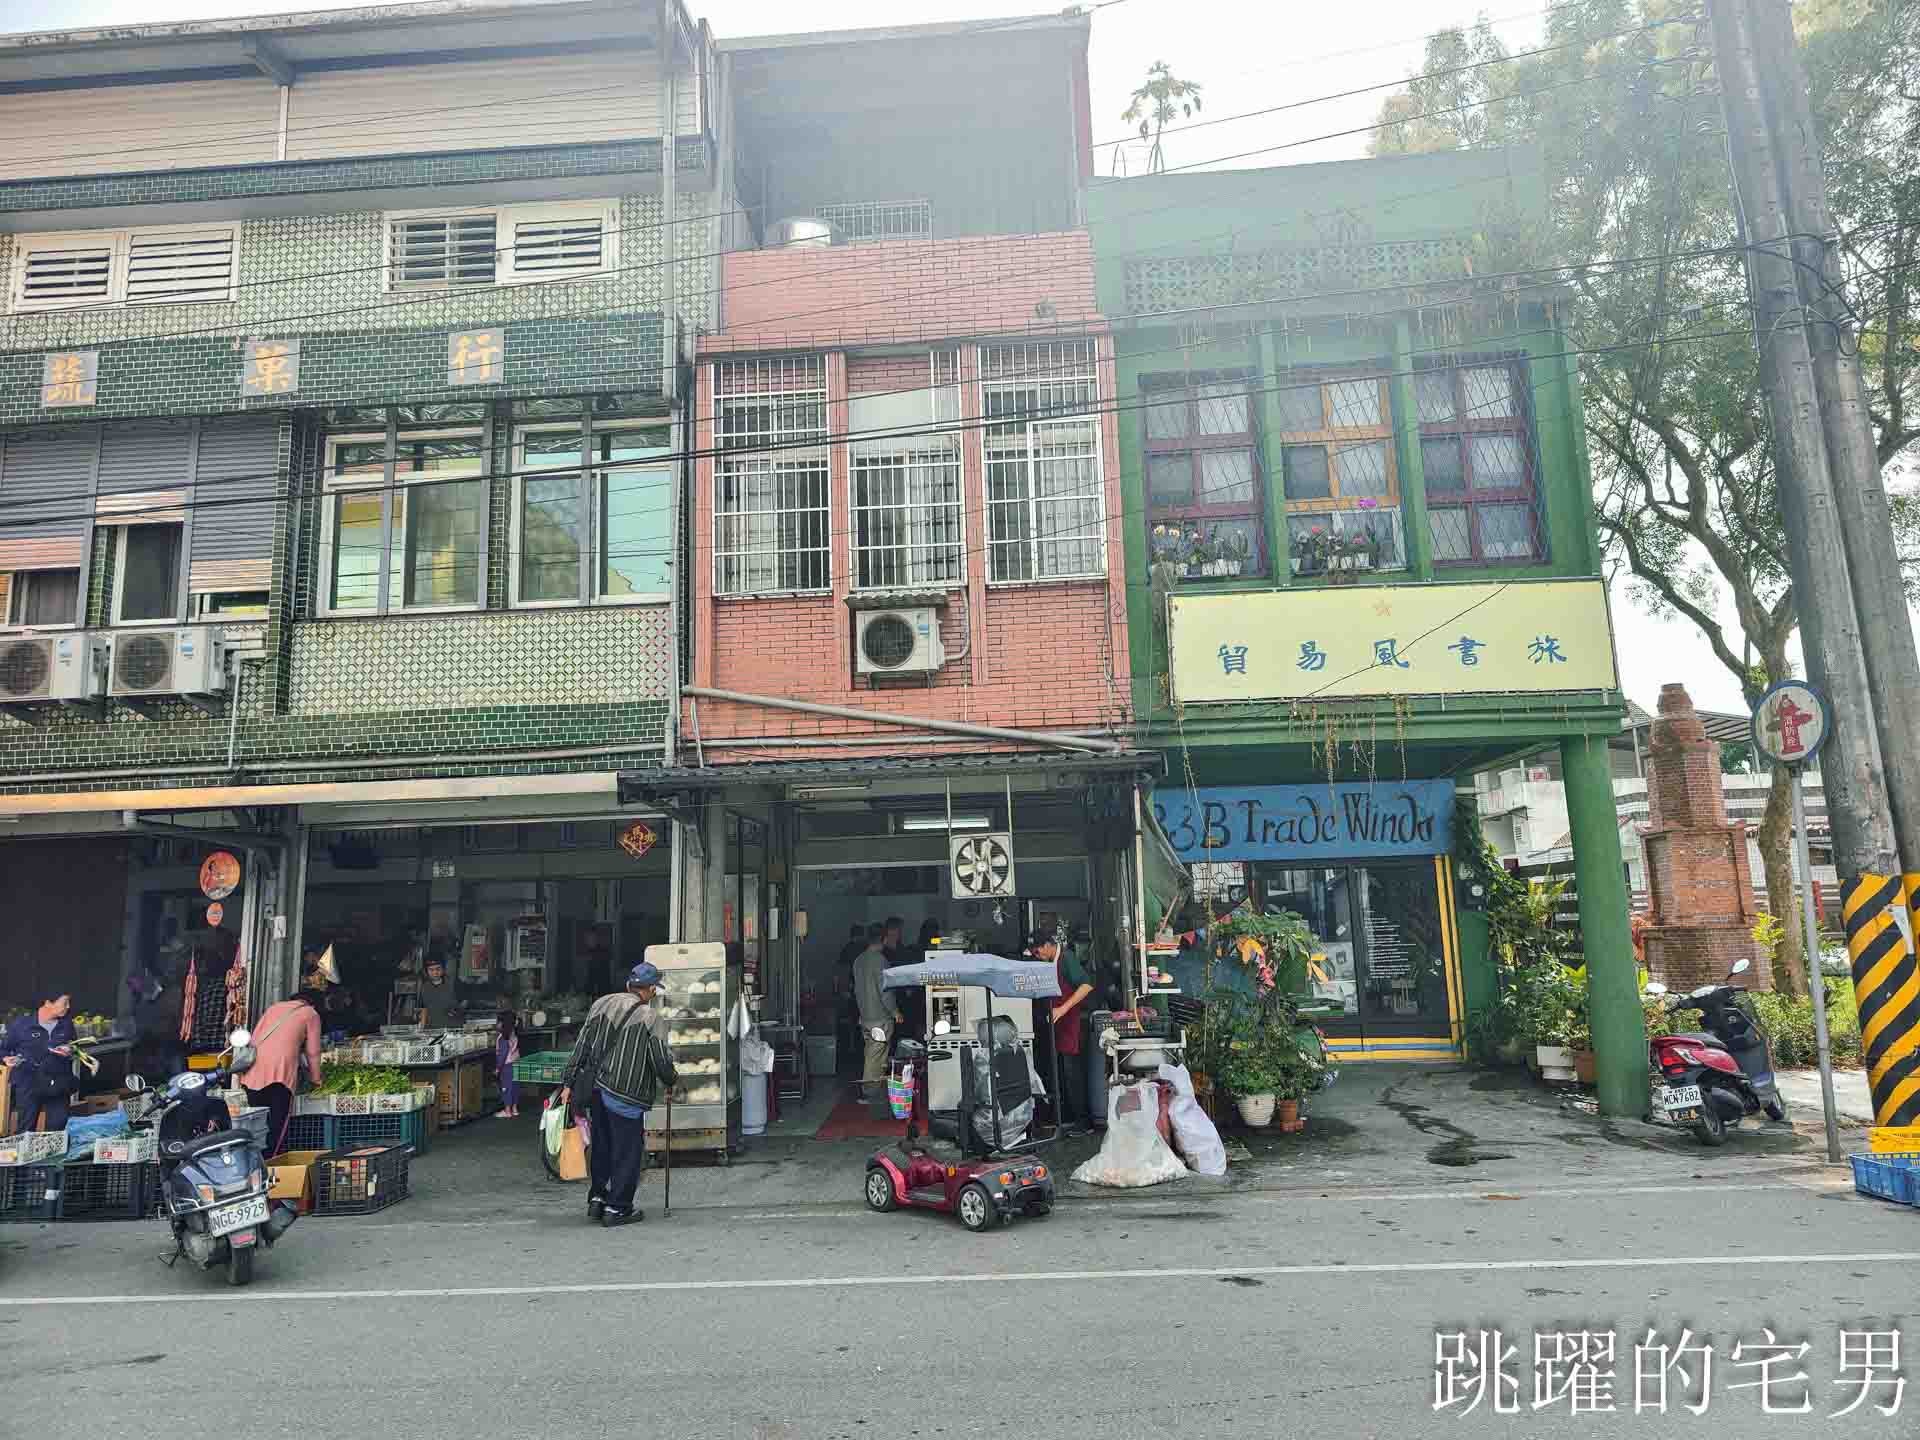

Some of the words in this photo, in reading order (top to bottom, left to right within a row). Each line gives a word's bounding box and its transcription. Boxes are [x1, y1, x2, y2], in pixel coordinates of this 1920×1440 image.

[1218, 635, 1568, 675] 貿易風書旅
[1239, 794, 1337, 844] Trade
